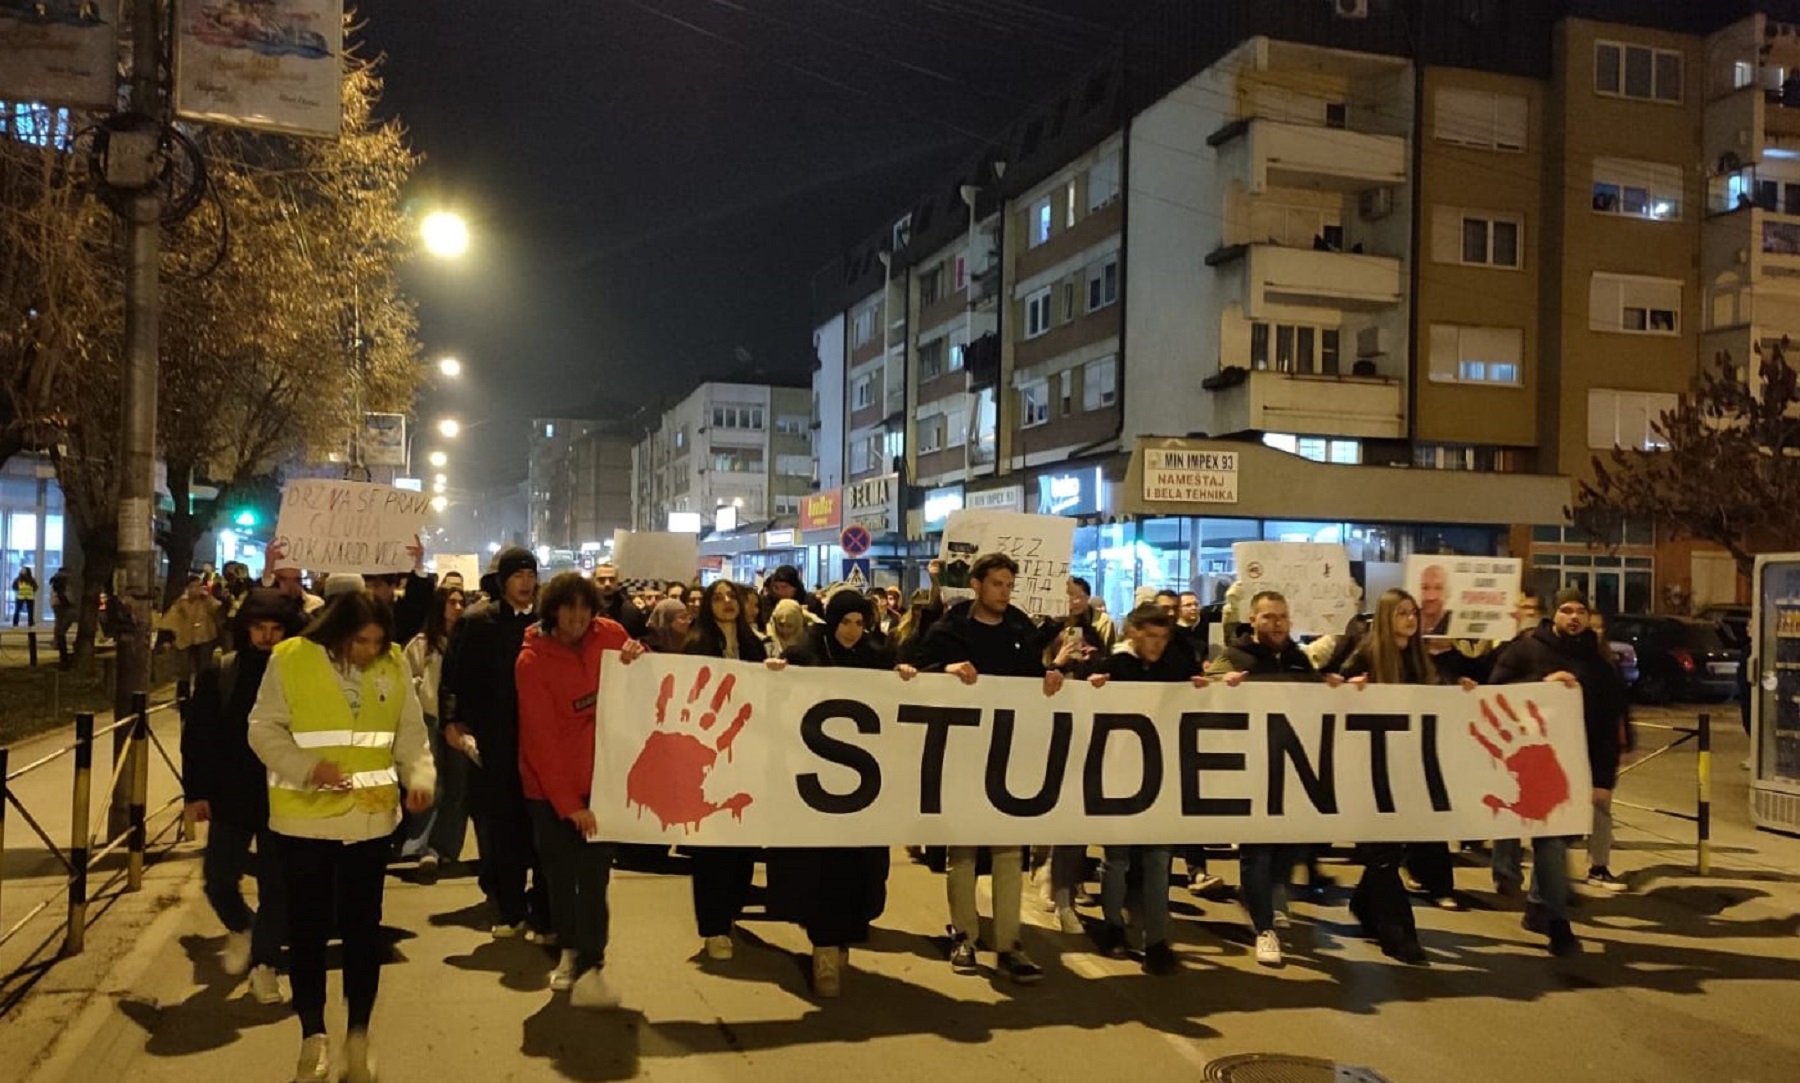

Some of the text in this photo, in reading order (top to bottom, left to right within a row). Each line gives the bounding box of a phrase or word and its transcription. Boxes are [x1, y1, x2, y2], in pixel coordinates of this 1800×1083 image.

[1165, 452, 1233, 470] MIN IMPEX 93
[1154, 489, 1182, 499] BELA
[1185, 489, 1234, 500] TEHNIKA
[795, 699, 1453, 817] STUDENTI
